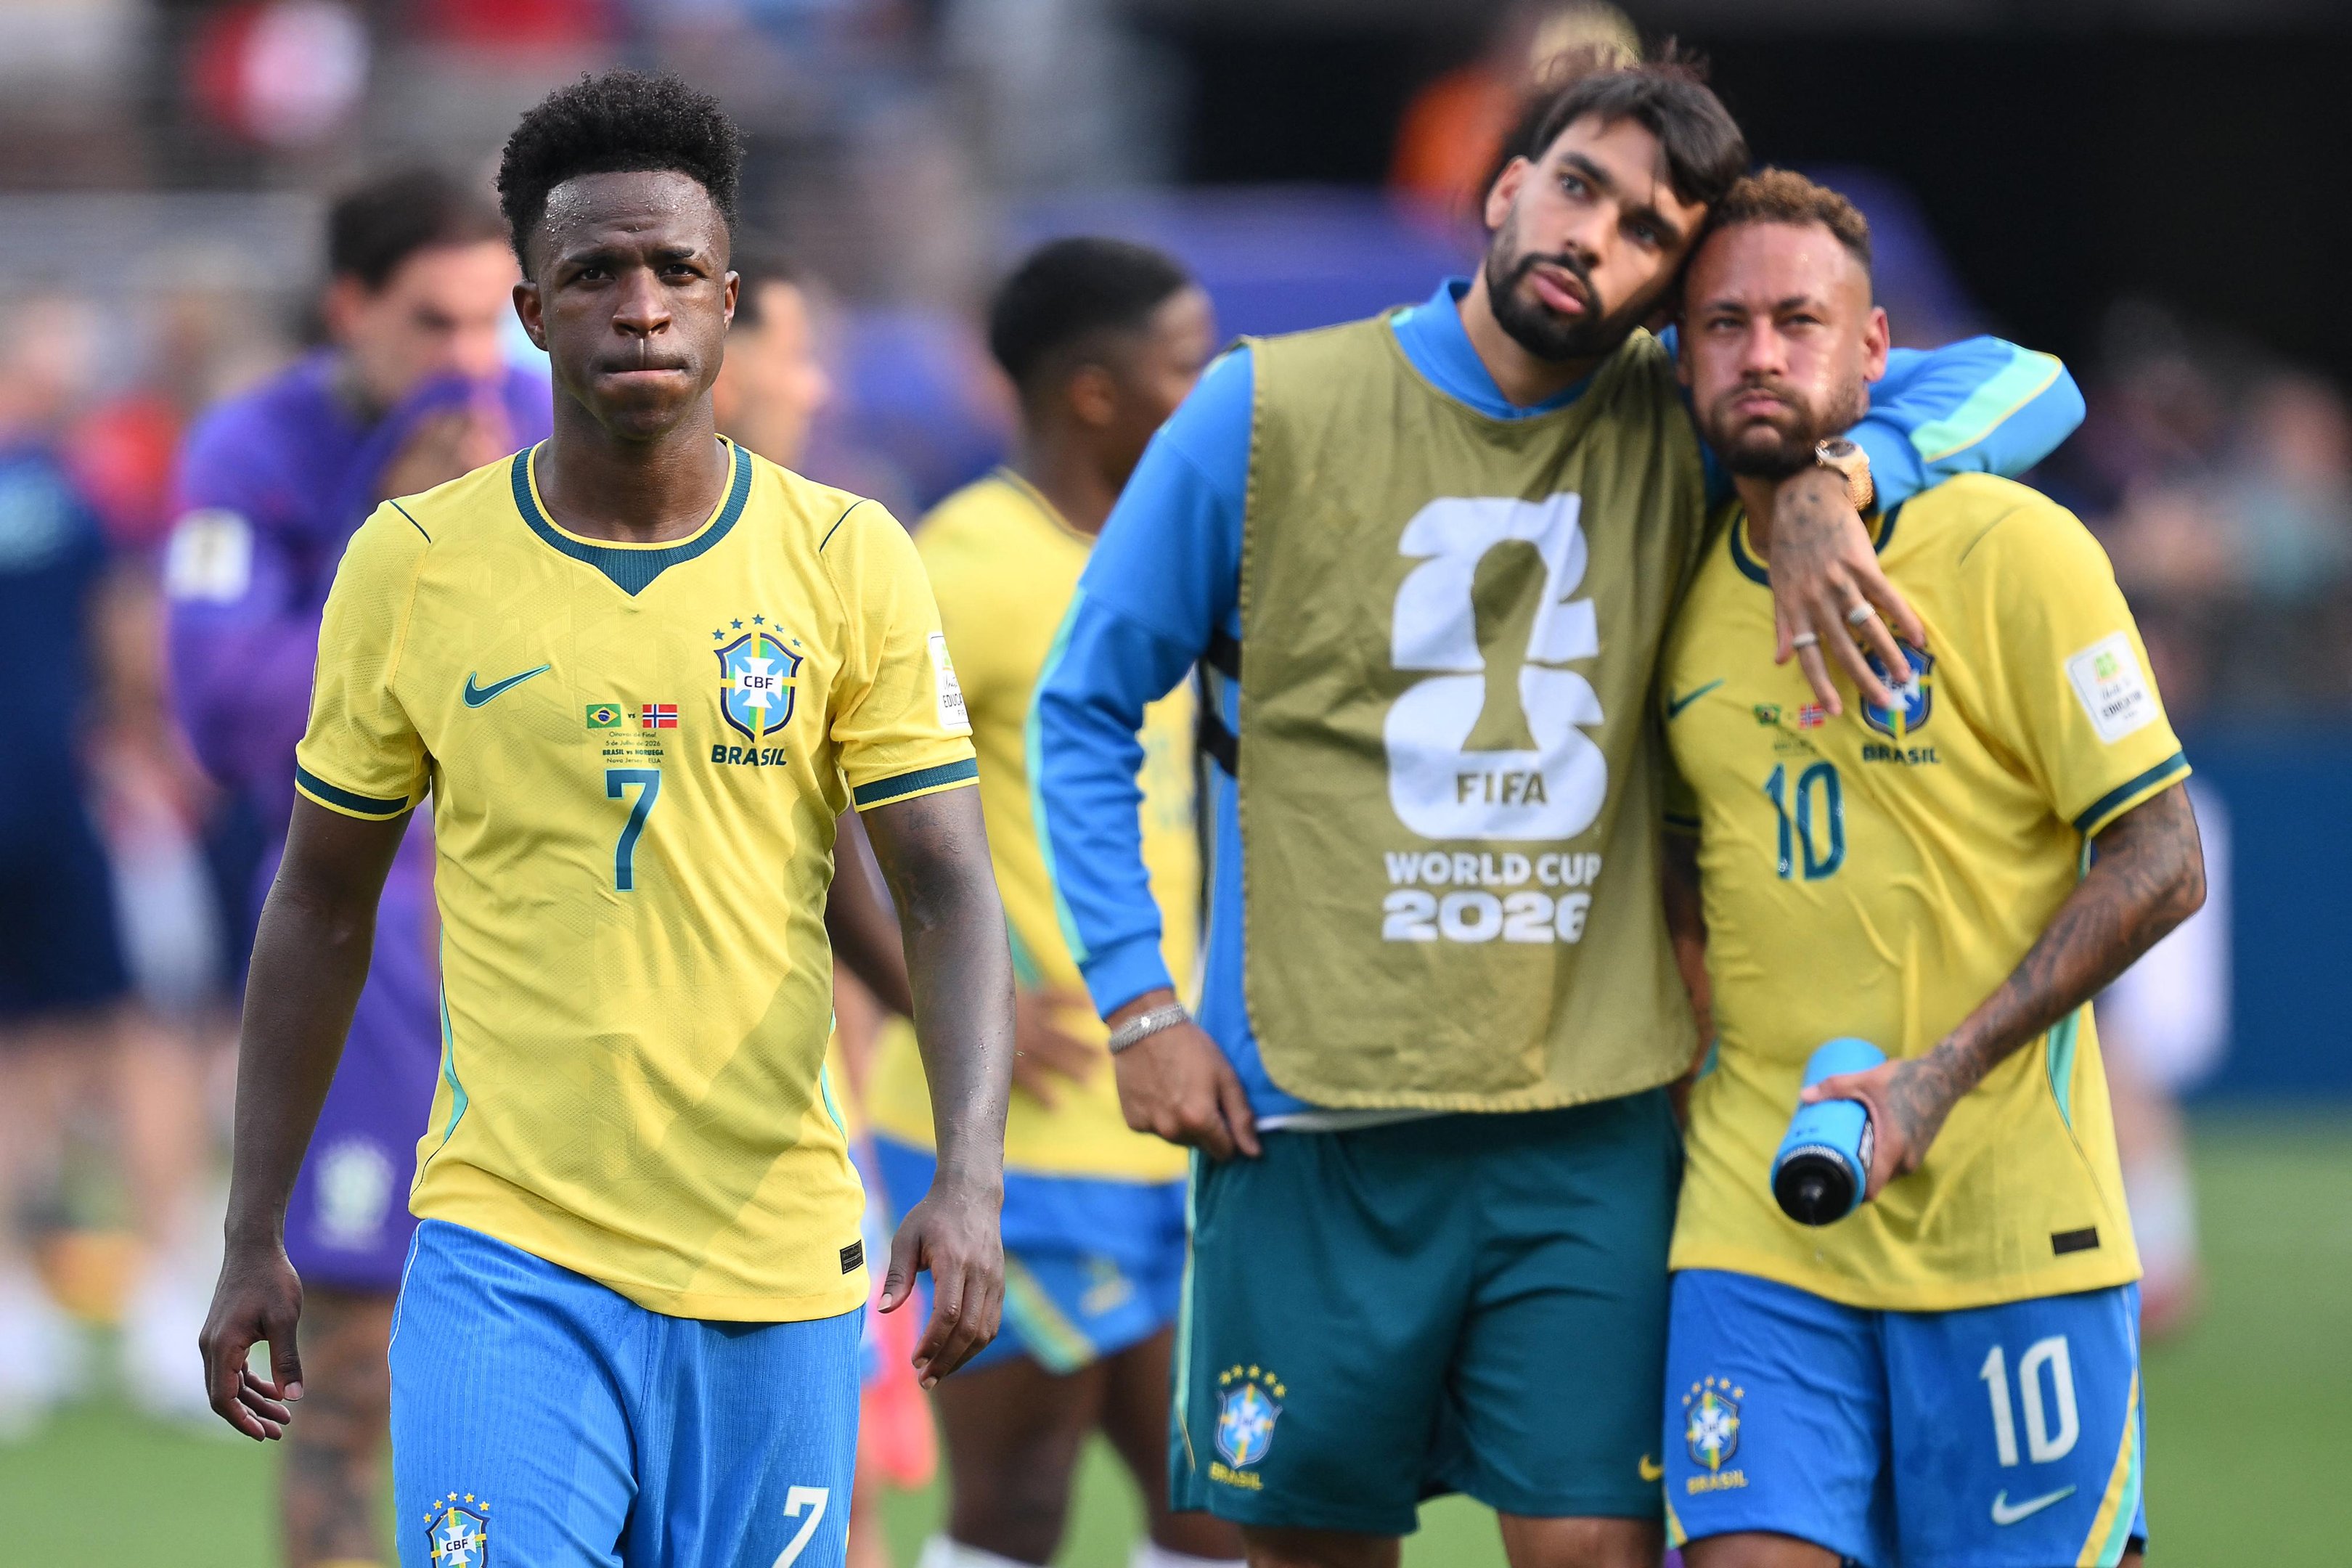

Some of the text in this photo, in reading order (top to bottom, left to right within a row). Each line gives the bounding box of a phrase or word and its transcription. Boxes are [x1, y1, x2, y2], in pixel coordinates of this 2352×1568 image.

[743, 674, 774, 690] CBF
[711, 745, 788, 767] BRASIL
[1863, 744, 1940, 764] BRASIL
[1456, 771, 1548, 807] FIFA
[604, 768, 662, 892] 7
[1762, 760, 1847, 882] 10
[1383, 851, 1602, 887] WORLD CUP
[1381, 888, 1593, 944] 2026
[1979, 1334, 2081, 1469] 10
[772, 1485, 830, 1568] 7
[446, 1538, 468, 1552] CBF
